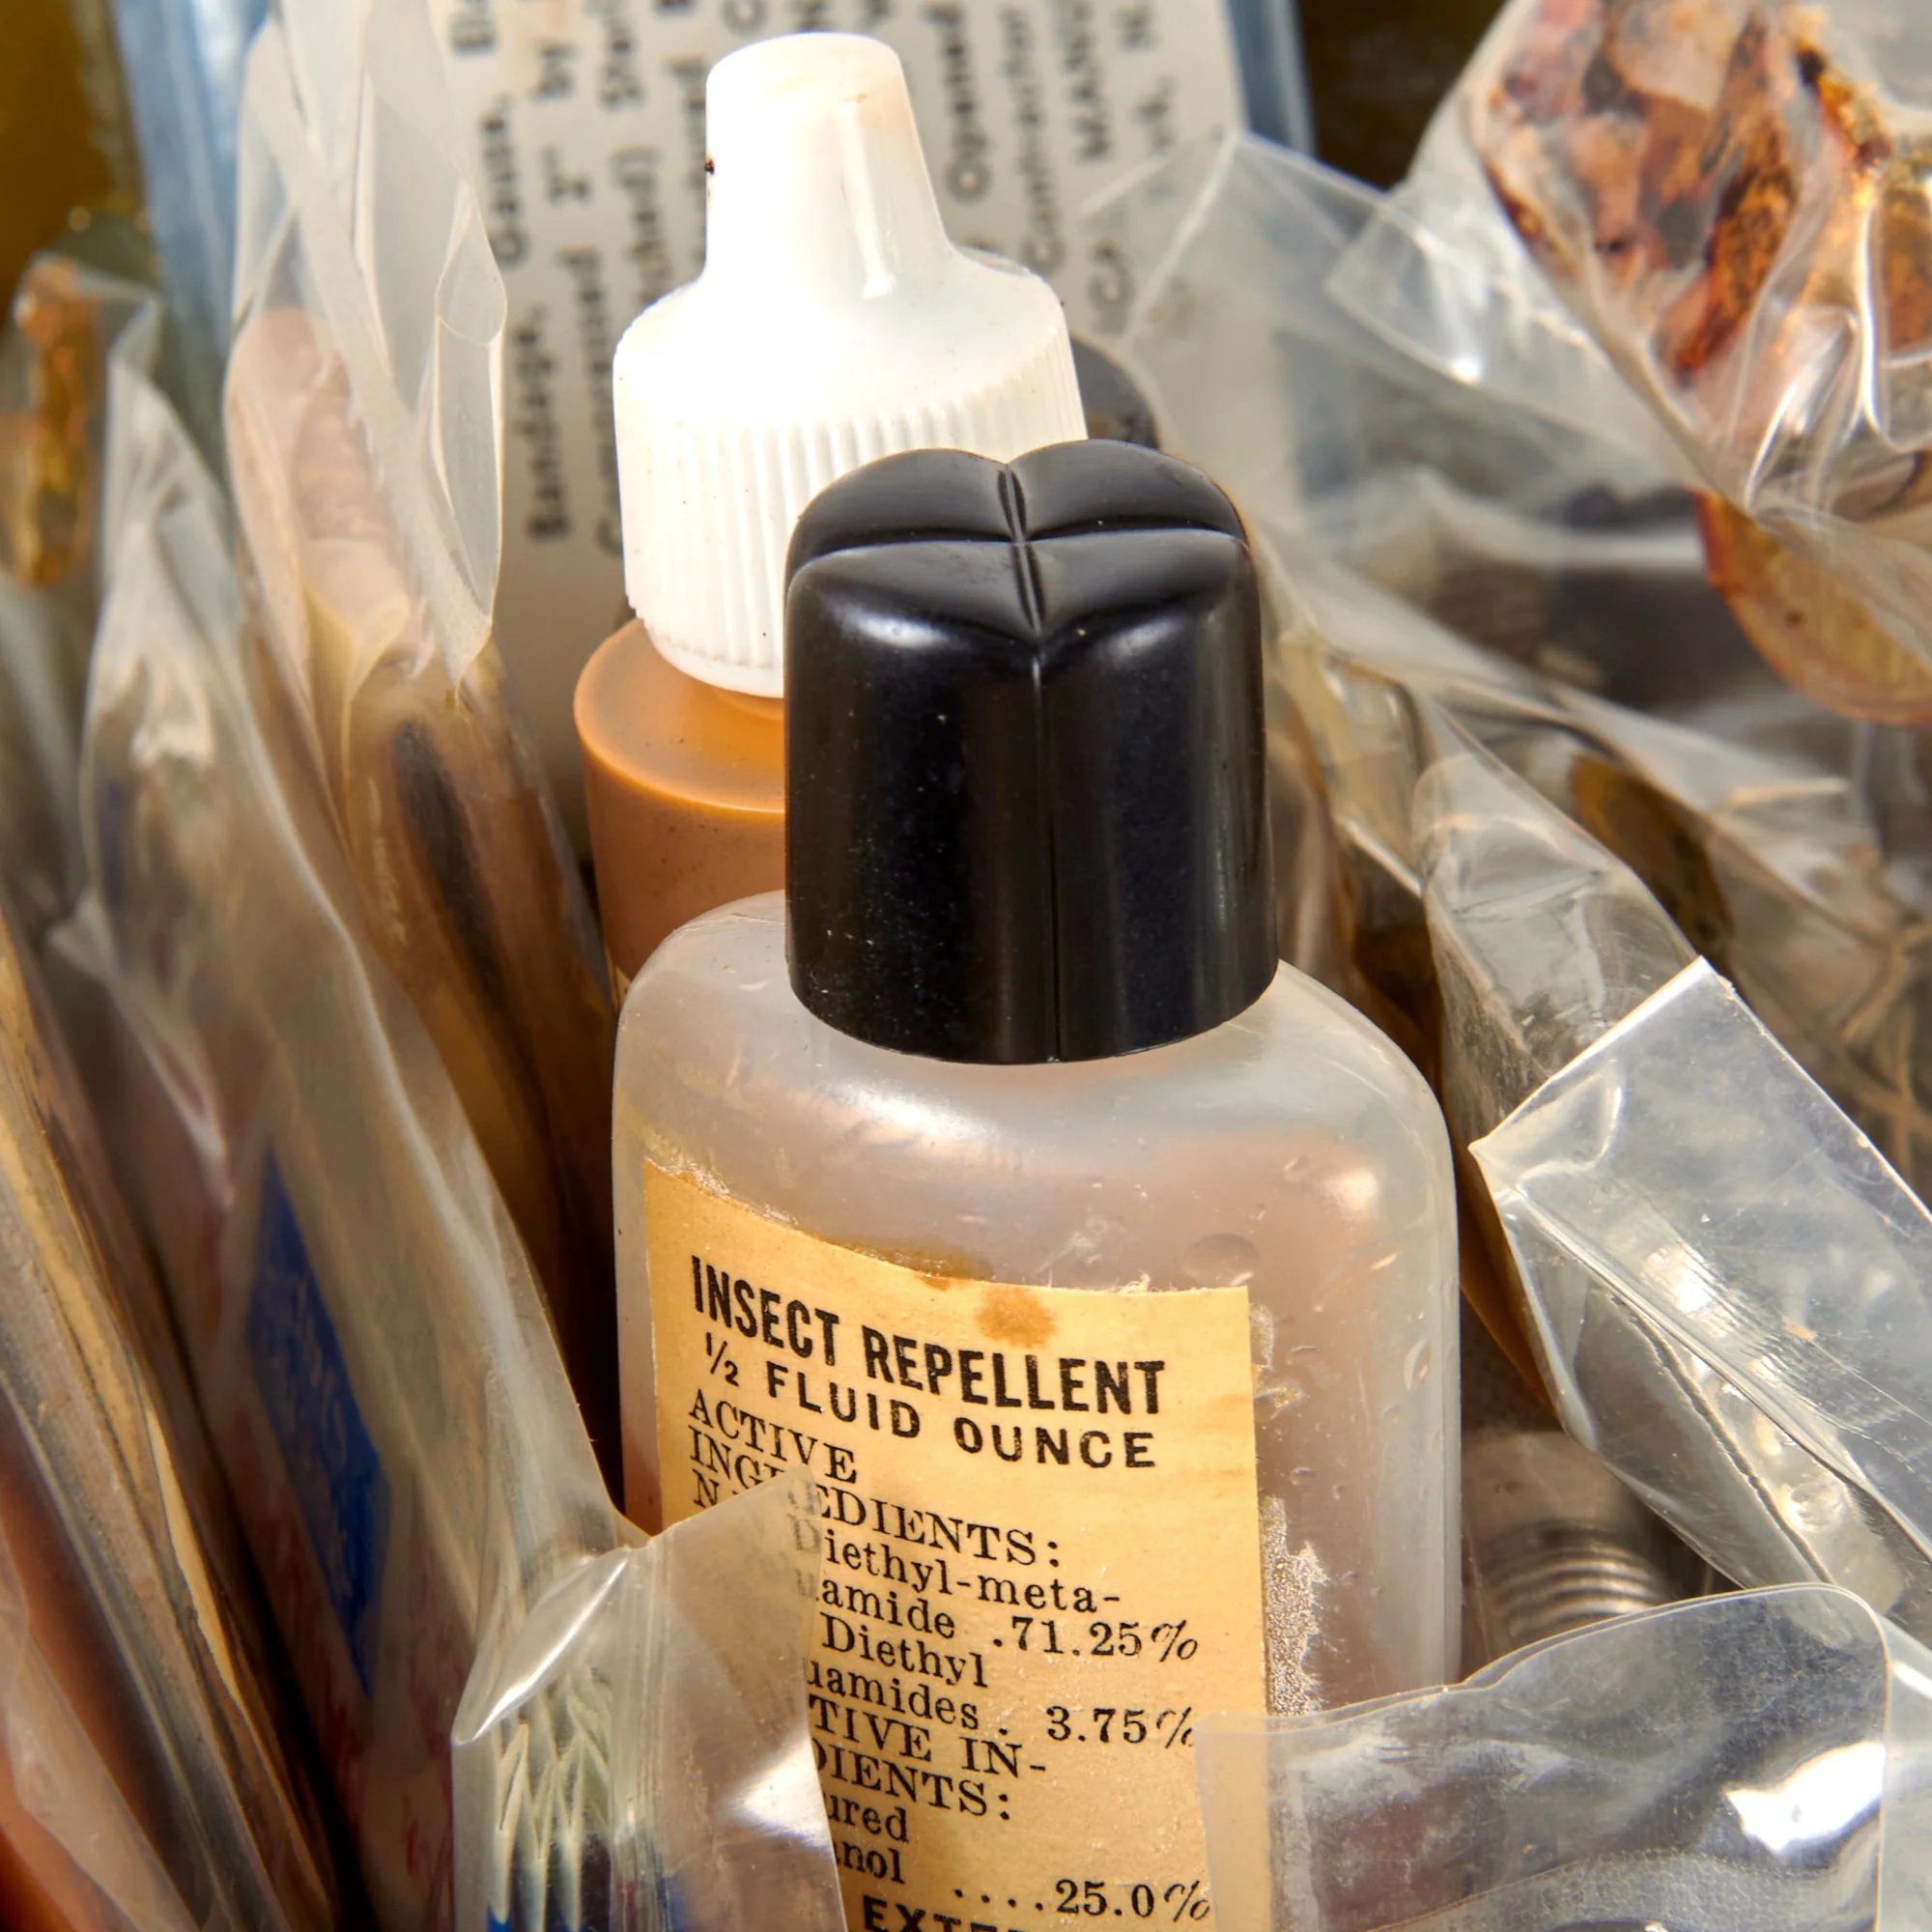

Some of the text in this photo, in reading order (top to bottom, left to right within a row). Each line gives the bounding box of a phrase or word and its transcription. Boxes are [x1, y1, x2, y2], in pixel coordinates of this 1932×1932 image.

[692, 1255, 1165, 1415] INSECT REPELLENT
[689, 1388, 858, 1484] ACTIVE
[766, 1359, 921, 1439] FLUID
[953, 1416, 1156, 1469] OUNCE
[819, 1611, 988, 1689] Diethyl
[958, 1735, 1047, 1778] IN-
[1046, 1705, 1194, 1749] 3.75%
[833, 1838, 906, 1885] nol
